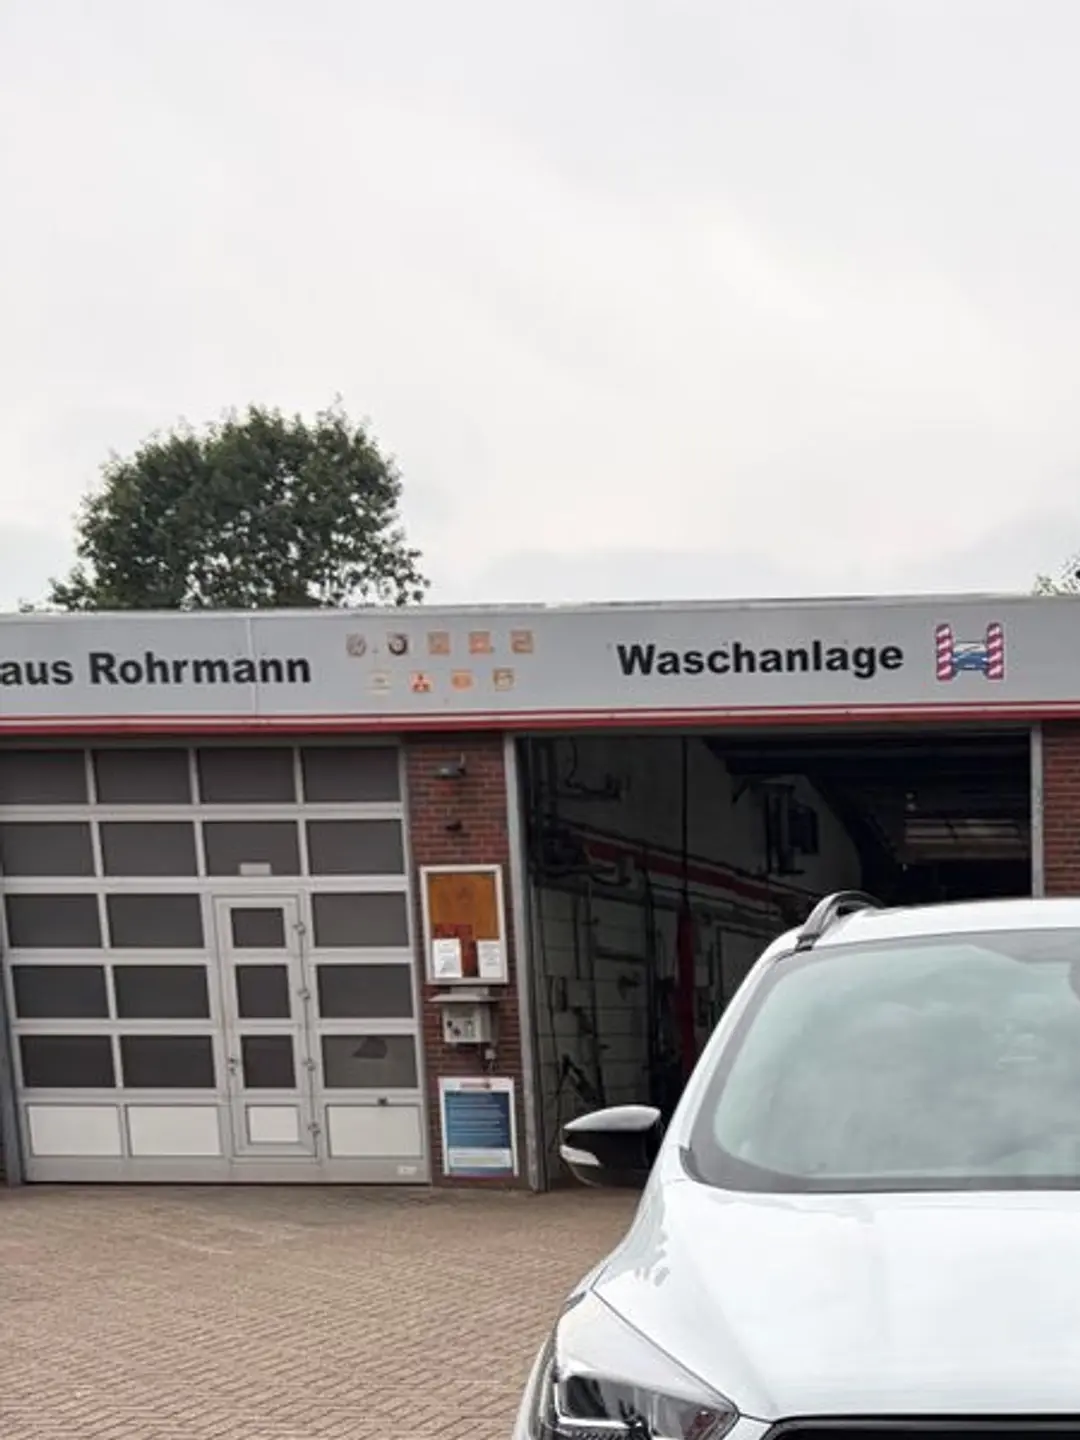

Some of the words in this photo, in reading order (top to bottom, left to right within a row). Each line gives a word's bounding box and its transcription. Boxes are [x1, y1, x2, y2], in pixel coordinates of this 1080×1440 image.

[0, 660, 74, 686] aus
[88, 652, 311, 685] Rohrmann
[617, 641, 904, 680] Waschanlage
